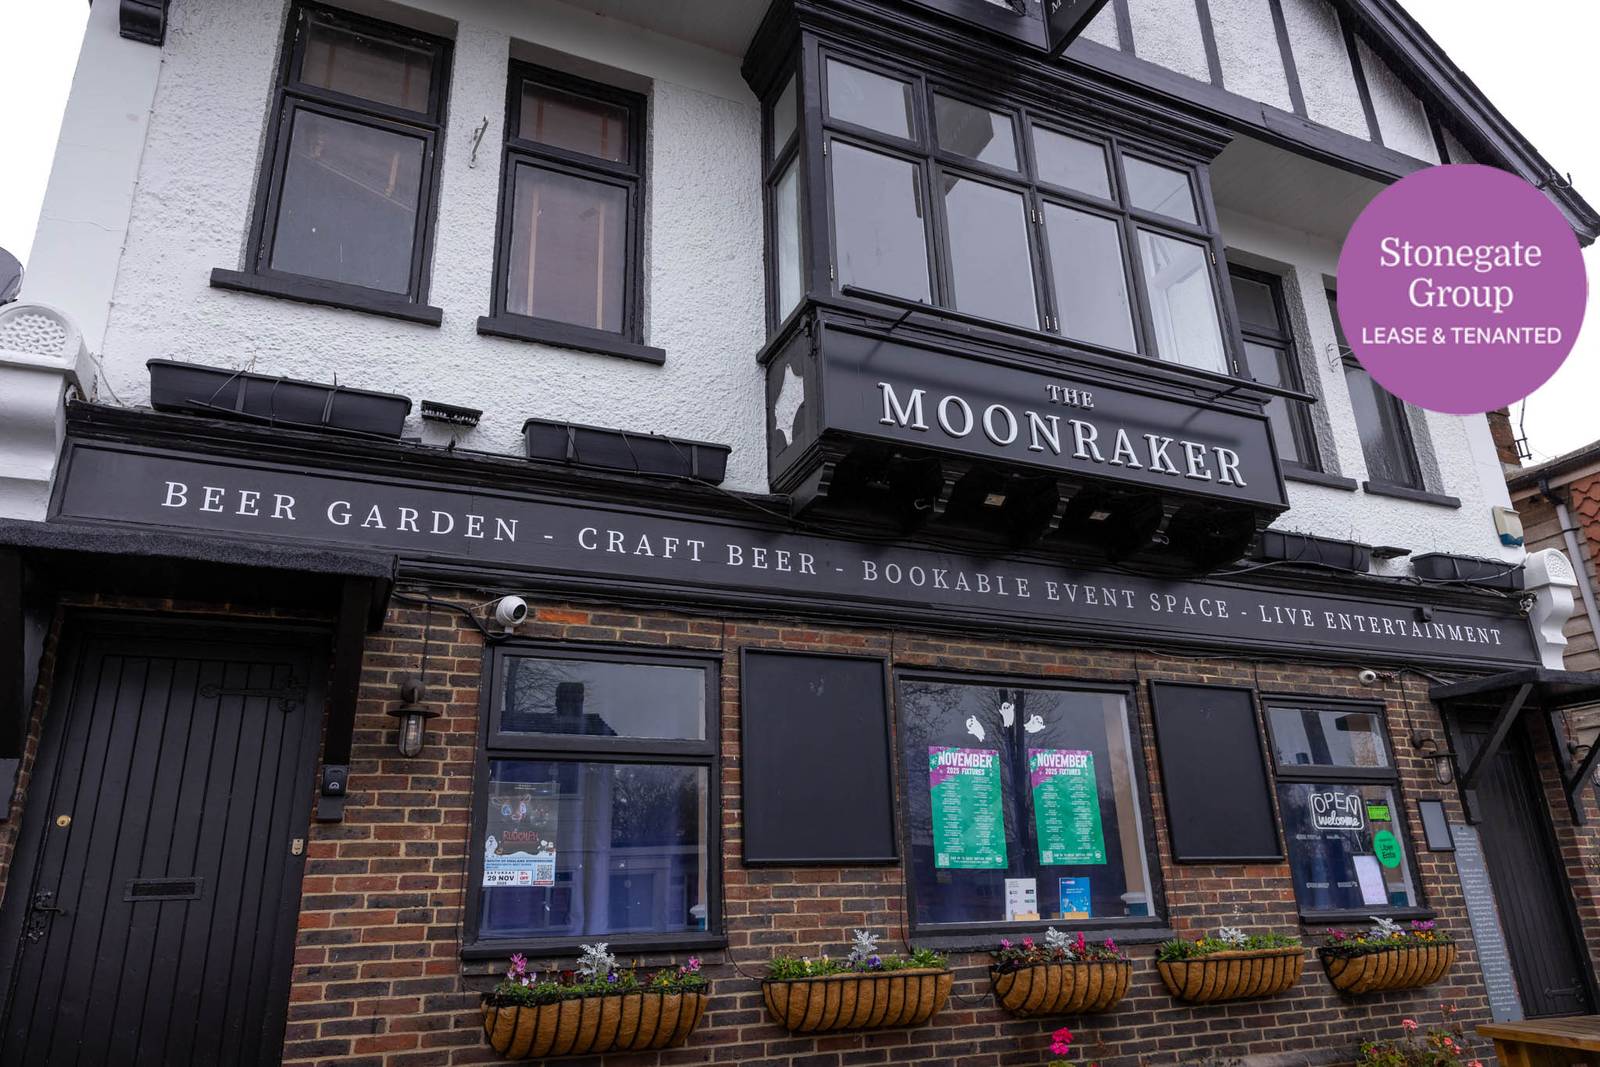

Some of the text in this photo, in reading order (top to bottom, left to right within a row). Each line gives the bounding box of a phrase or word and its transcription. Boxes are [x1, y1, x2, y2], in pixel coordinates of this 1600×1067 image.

[1046, 384, 1095, 409] THE
[877, 382, 1247, 488] MOONRAKER
[160, 481, 297, 521] BEER
[326, 500, 519, 543] GARDEN
[577, 527, 705, 562] CRAFT
[726, 544, 817, 575] BEER
[862, 560, 1030, 598] BOOKABLE
[1045, 581, 1135, 609] EVENT
[1149, 592, 1229, 619] SPACE
[1258, 604, 1315, 627] LIVE
[1323, 611, 1502, 645] ENTERTAINMENT
[938, 751, 992, 768] NOVEMBER
[1036, 753, 1087, 768] NOVEMBER
[946, 766, 985, 776] 2025 FIXTURES
[1313, 792, 1358, 815] OPEN
[1318, 810, 1360, 827] welcome
